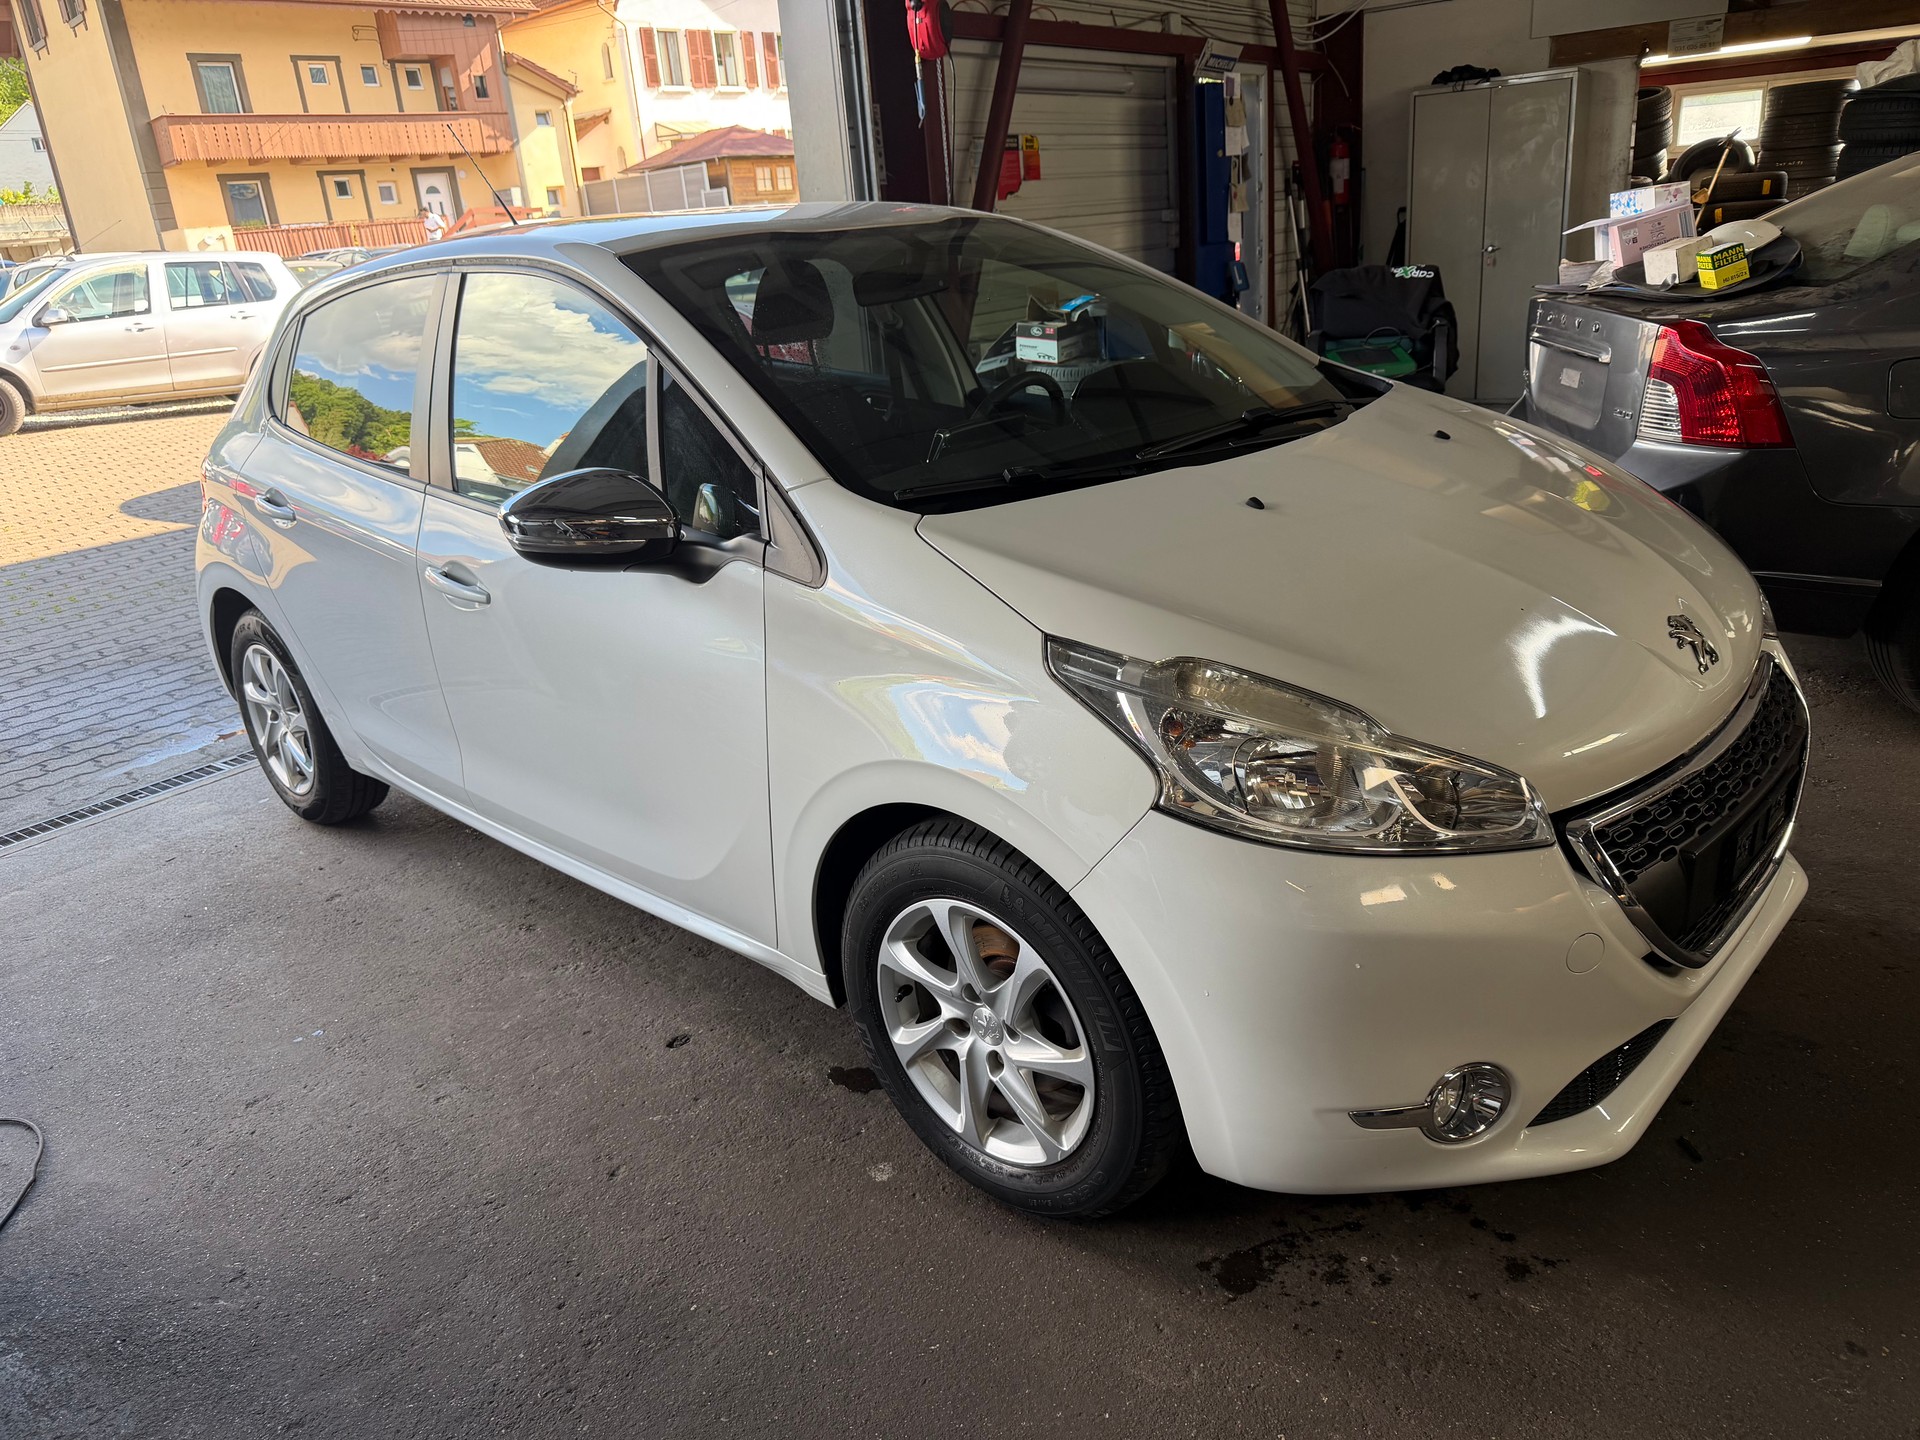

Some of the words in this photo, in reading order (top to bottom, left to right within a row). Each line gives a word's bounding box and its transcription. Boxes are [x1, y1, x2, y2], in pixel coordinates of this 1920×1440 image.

[1713, 245, 1744, 262] MANN
[1714, 252, 1746, 269] FILTER
[1028, 912, 1126, 1051] MICHELIN
